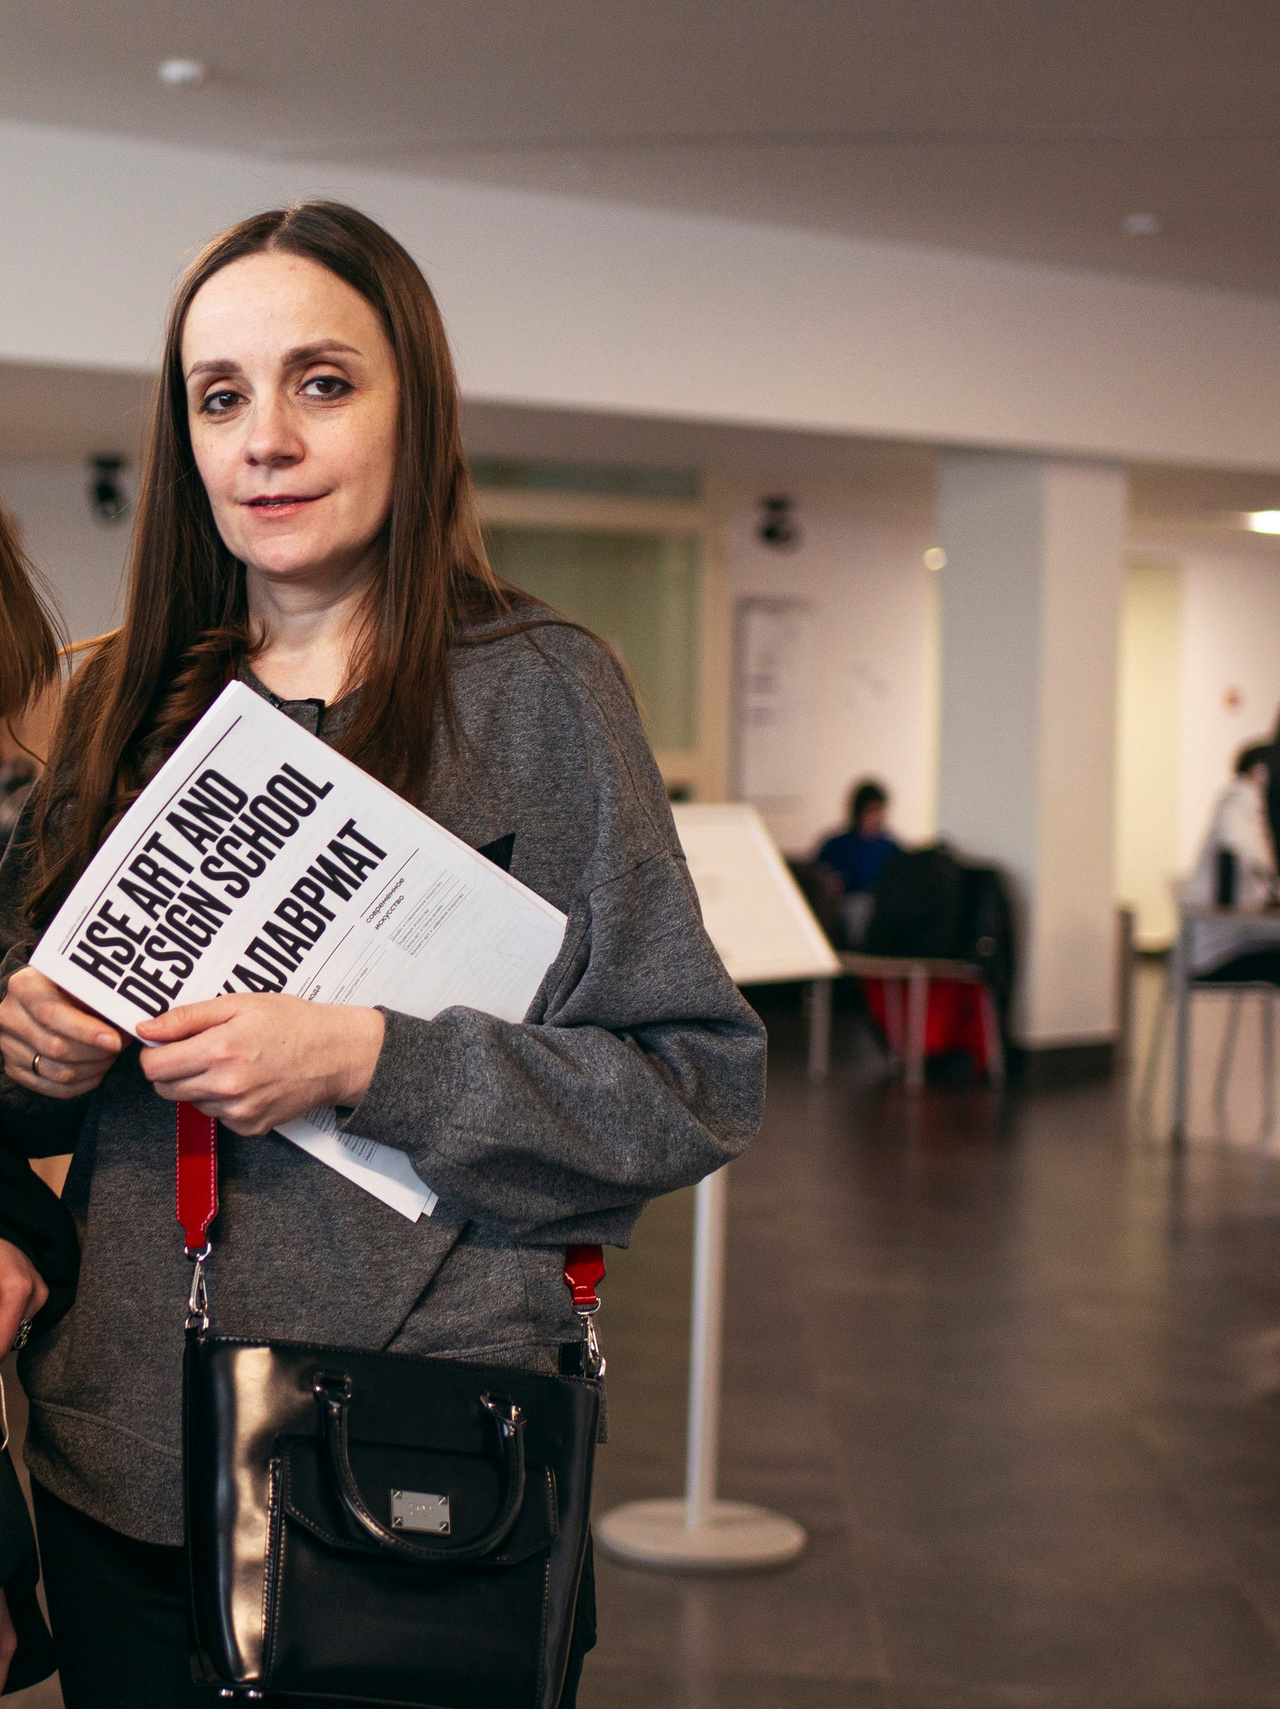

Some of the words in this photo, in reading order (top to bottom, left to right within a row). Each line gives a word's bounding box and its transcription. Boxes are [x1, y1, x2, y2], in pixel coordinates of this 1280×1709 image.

[68, 899, 131, 989] HSE
[128, 831, 195, 922] ART
[165, 768, 249, 856] AND
[116, 874, 233, 1018] DESIGN
[200, 761, 335, 899] SCHOOL
[366, 877, 405, 924] современное
[374, 895, 405, 930] искусство
